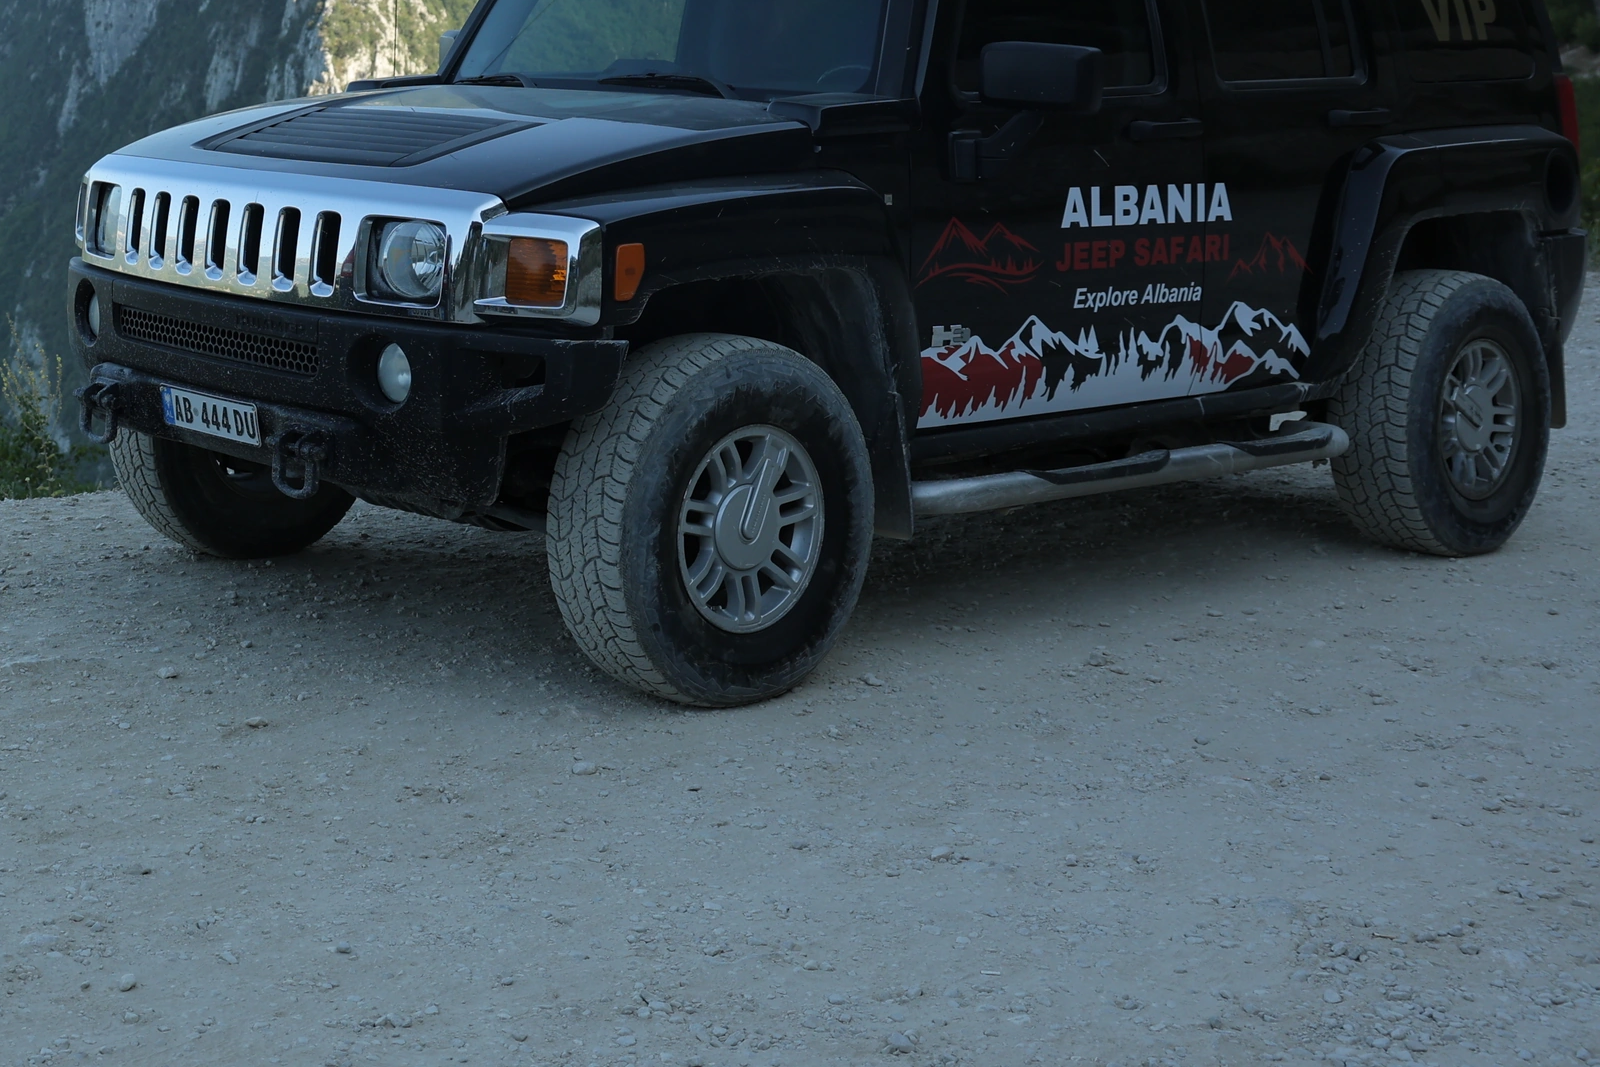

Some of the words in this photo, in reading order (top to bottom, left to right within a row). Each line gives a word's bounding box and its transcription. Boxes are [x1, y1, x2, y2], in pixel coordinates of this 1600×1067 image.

[1060, 182, 1233, 229] ALBANIA
[1055, 238, 1126, 272] JEEP
[1133, 233, 1230, 266] SAFARI
[1073, 286, 1138, 313] Explore
[1140, 281, 1203, 305] Albania
[175, 395, 193, 423] AB
[201, 401, 231, 433] 444
[232, 409, 256, 439] DU
